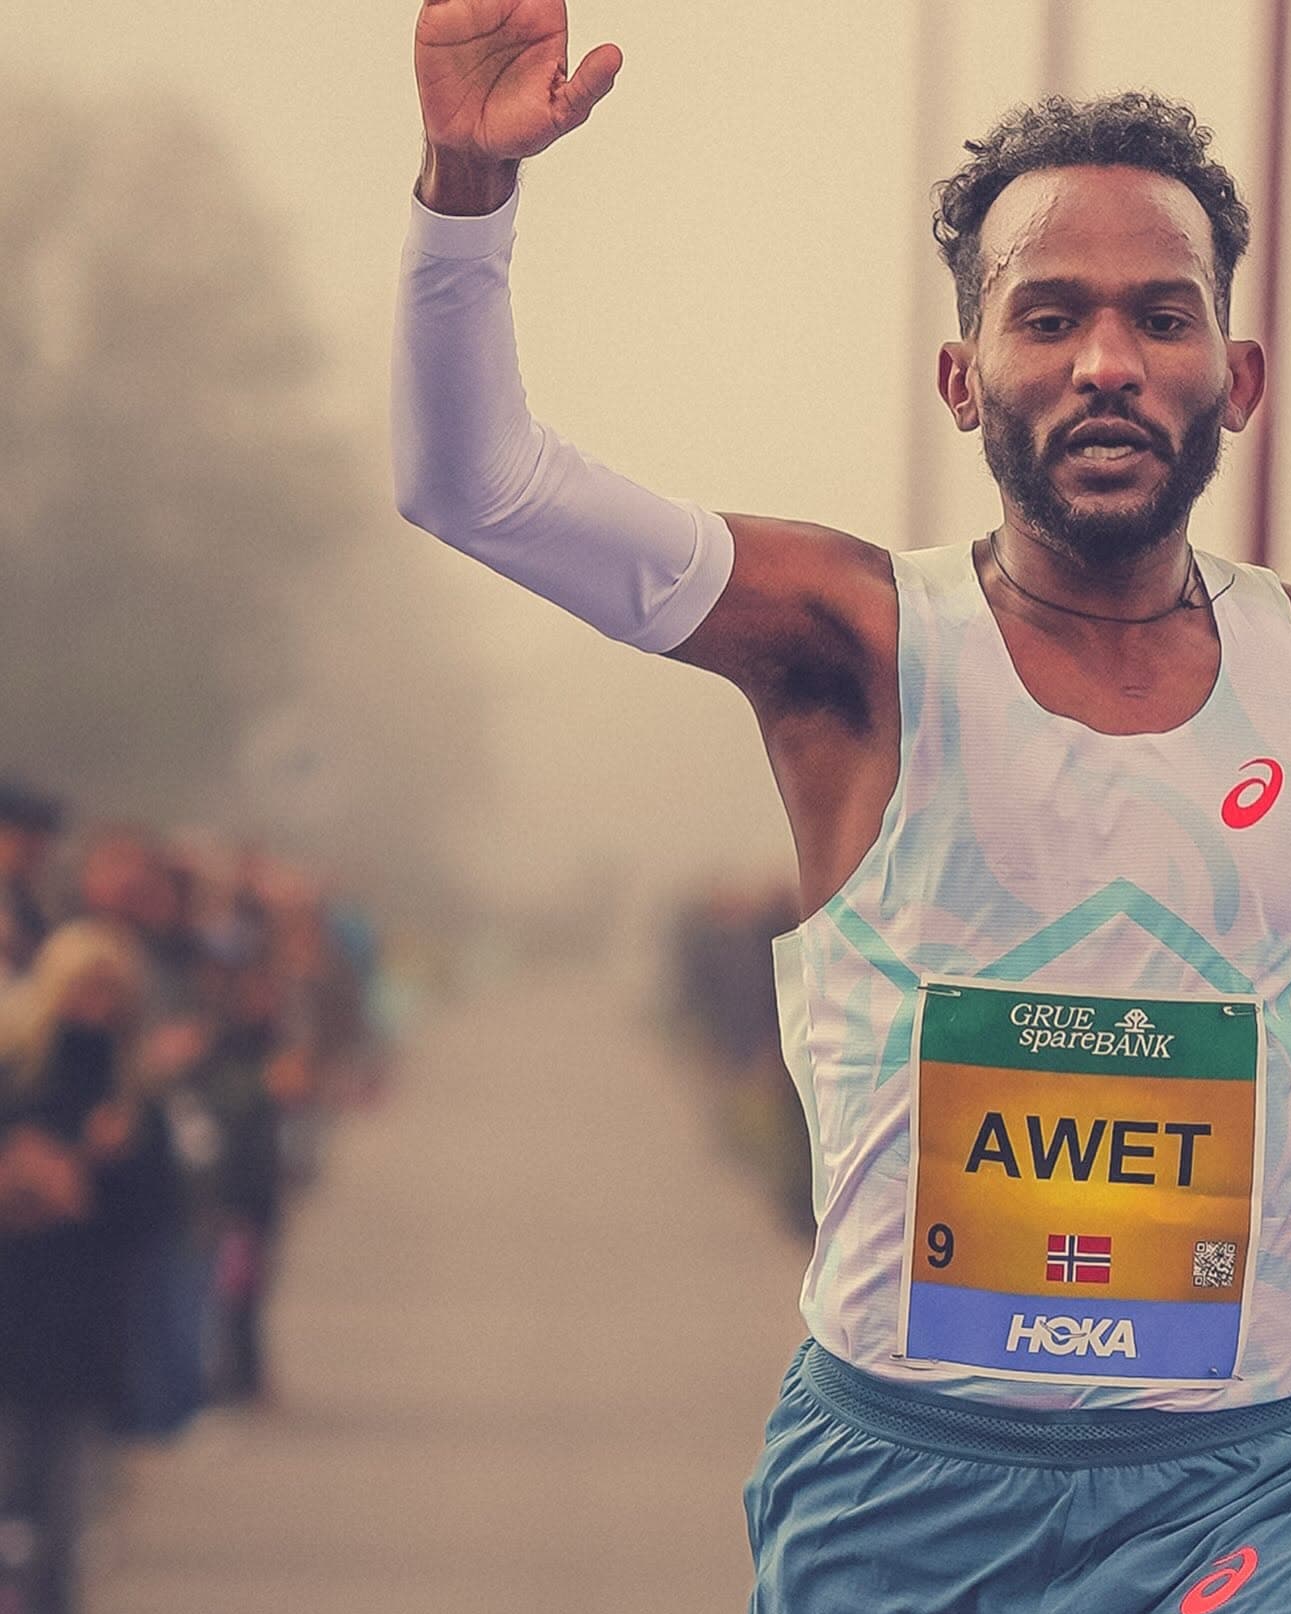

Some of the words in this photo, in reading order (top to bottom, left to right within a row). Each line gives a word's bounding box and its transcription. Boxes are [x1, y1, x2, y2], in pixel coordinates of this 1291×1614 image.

[1009, 1003, 1096, 1030] GRUE
[1019, 1025, 1176, 1059] spareBANK
[964, 1111, 1212, 1187] AWET
[927, 1223, 955, 1269] 9
[1006, 1314, 1138, 1359] HOKA
